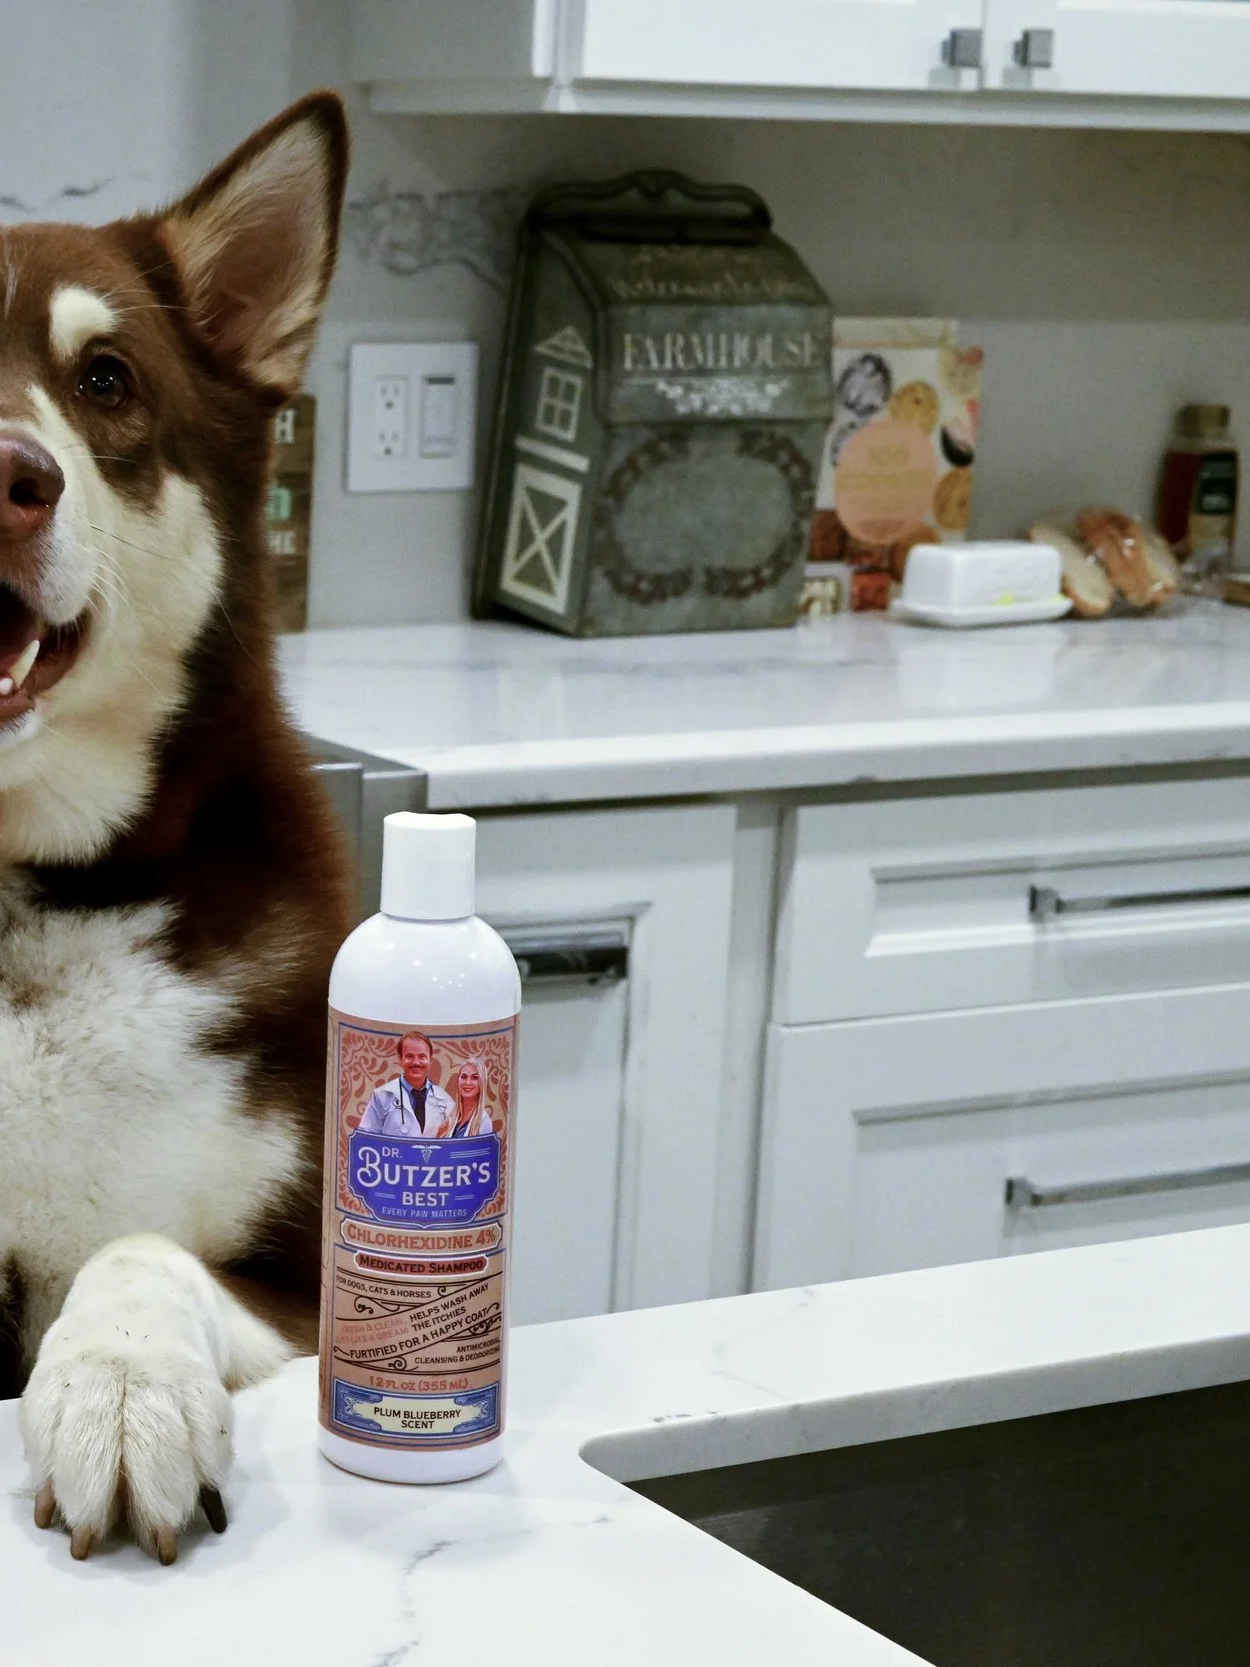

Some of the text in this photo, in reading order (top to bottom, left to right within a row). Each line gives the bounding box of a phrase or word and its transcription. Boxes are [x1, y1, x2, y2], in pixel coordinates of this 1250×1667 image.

[622, 330, 820, 371] FARMHOUSE
[382, 1146, 403, 1158] DR.
[356, 1146, 491, 1188] BUTZER'S
[402, 1192, 449, 1207] BEST
[382, 1206, 468, 1218] EVERY PAW MATTERS
[347, 1223, 496, 1250] CHLORHEXIDINE 4%
[359, 1254, 483, 1274] MEDICATED SHAMPOO
[336, 1275, 348, 1285] FOR
[348, 1279, 368, 1292] DOGS,
[369, 1285, 389, 1295] CATS
[397, 1289, 432, 1298] HORSES
[409, 1283, 489, 1322] HELPS WASH AWAY
[366, 1323, 374, 1331] &
[411, 1306, 467, 1332] THE ITCHIES
[350, 1308, 488, 1359] FURTIFIED FOR A HAPPY COAT
[375, 1327, 409, 1341] DREAM
[459, 1355, 464, 1363] &
[370, 1375, 385, 1387] 12
[418, 1380, 447, 1392] (355
[373, 1406, 461, 1420] PLUM BLUEBERRY
[401, 1420, 434, 1429] SCENT
